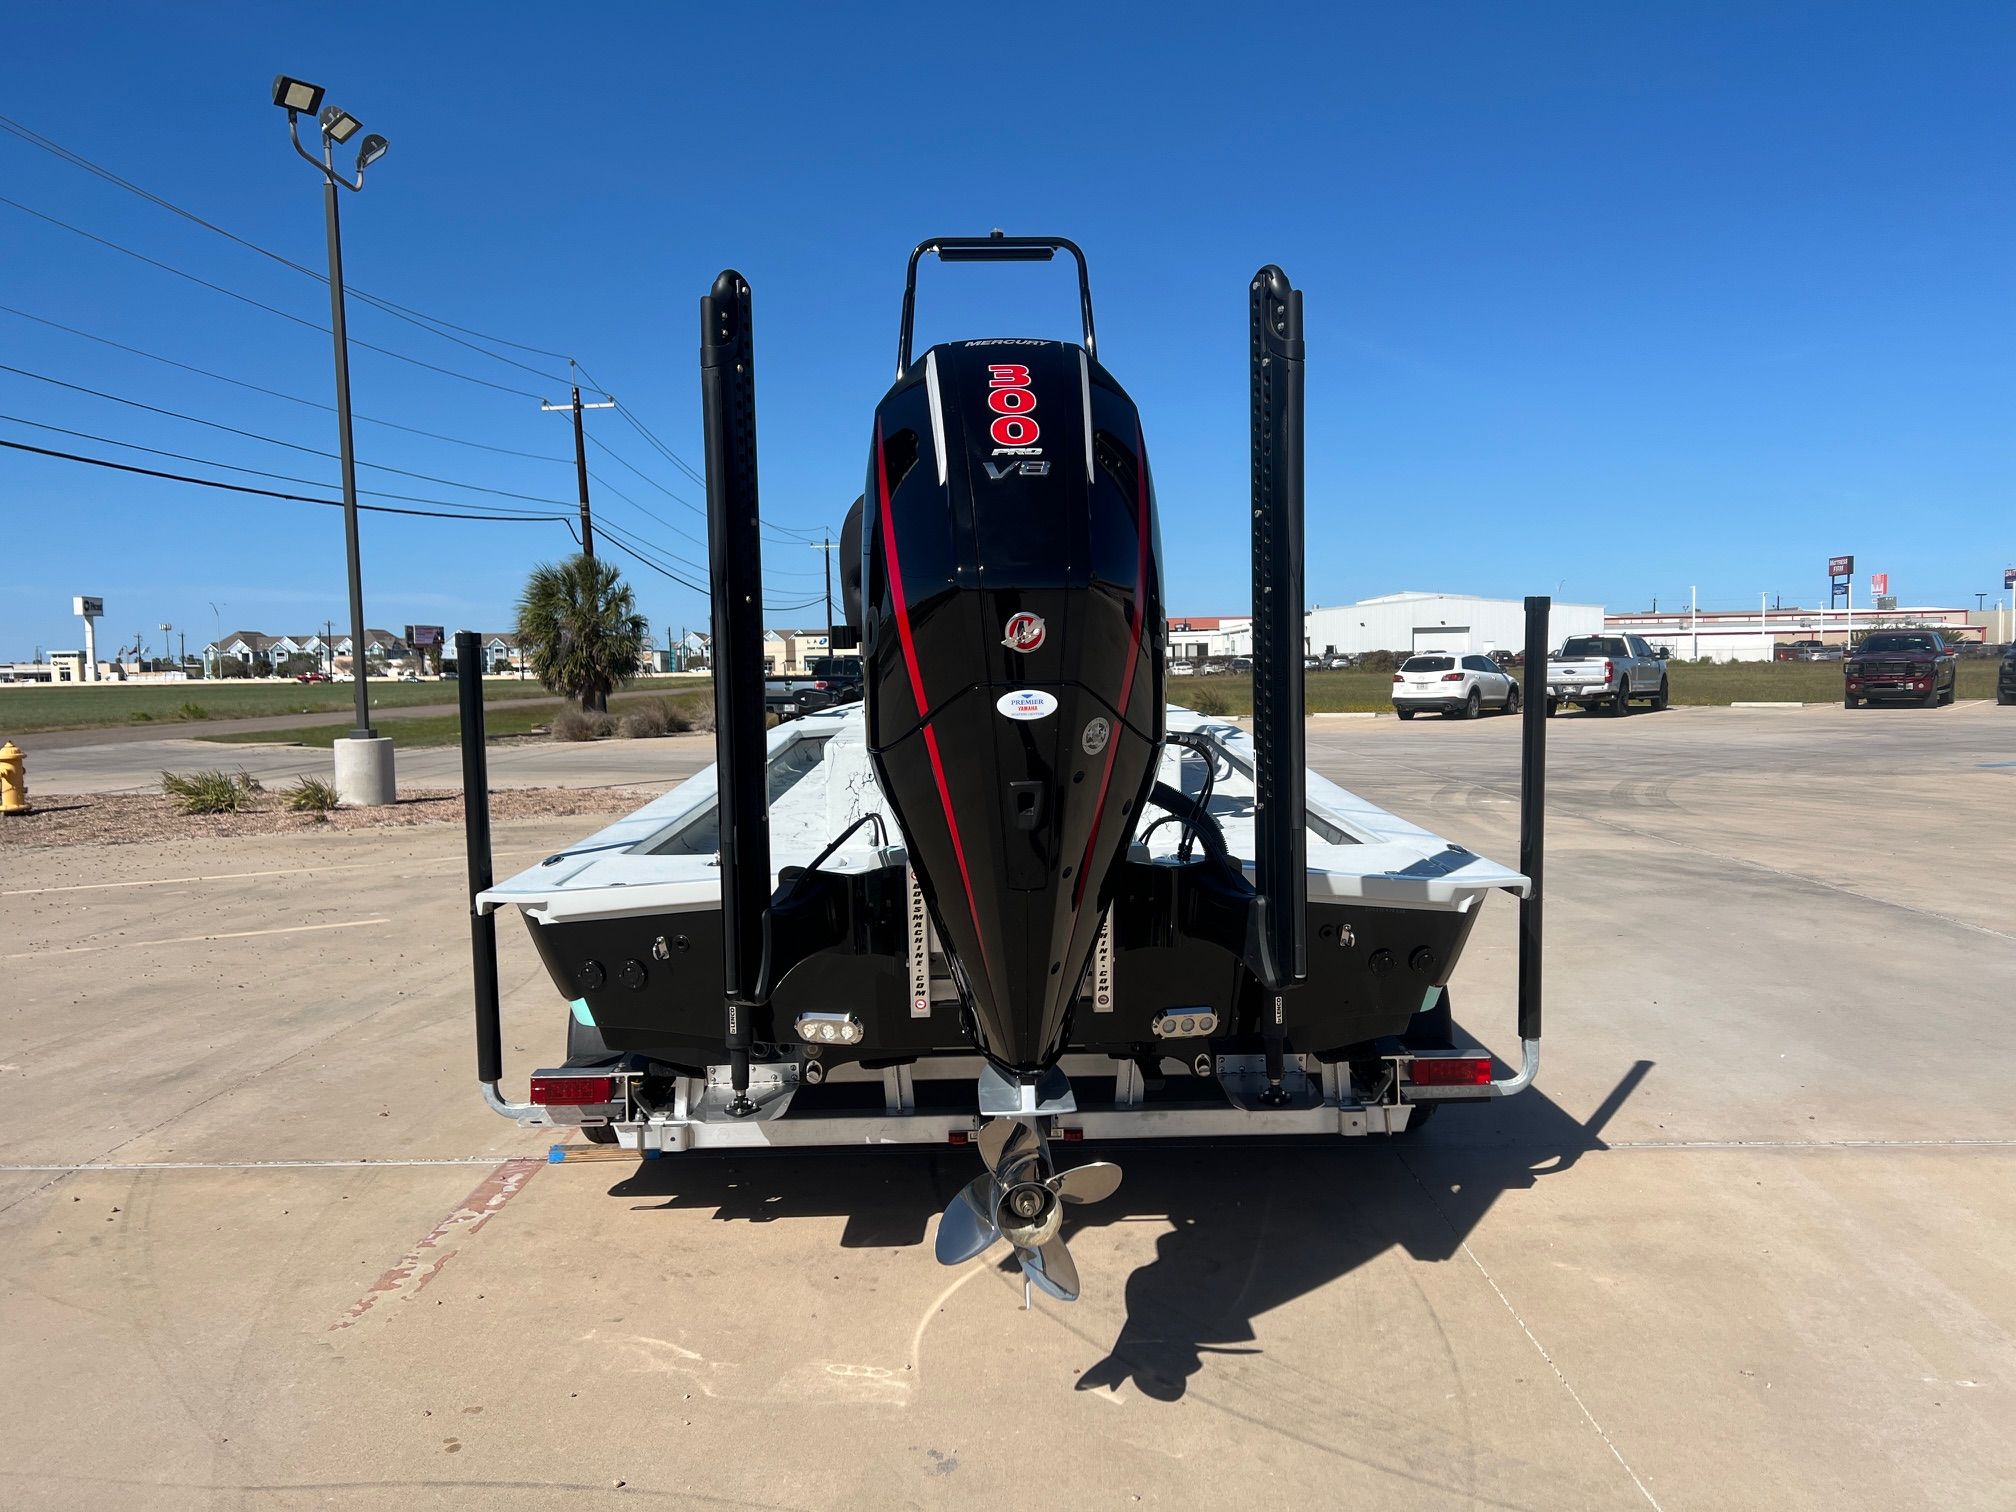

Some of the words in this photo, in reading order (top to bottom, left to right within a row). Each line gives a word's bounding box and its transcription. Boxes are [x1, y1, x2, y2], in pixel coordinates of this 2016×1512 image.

[964, 339, 1051, 347] MERCURY
[987, 364, 1040, 446] 300
[991, 447, 1043, 456] PRO
[982, 460, 1051, 480] V8
